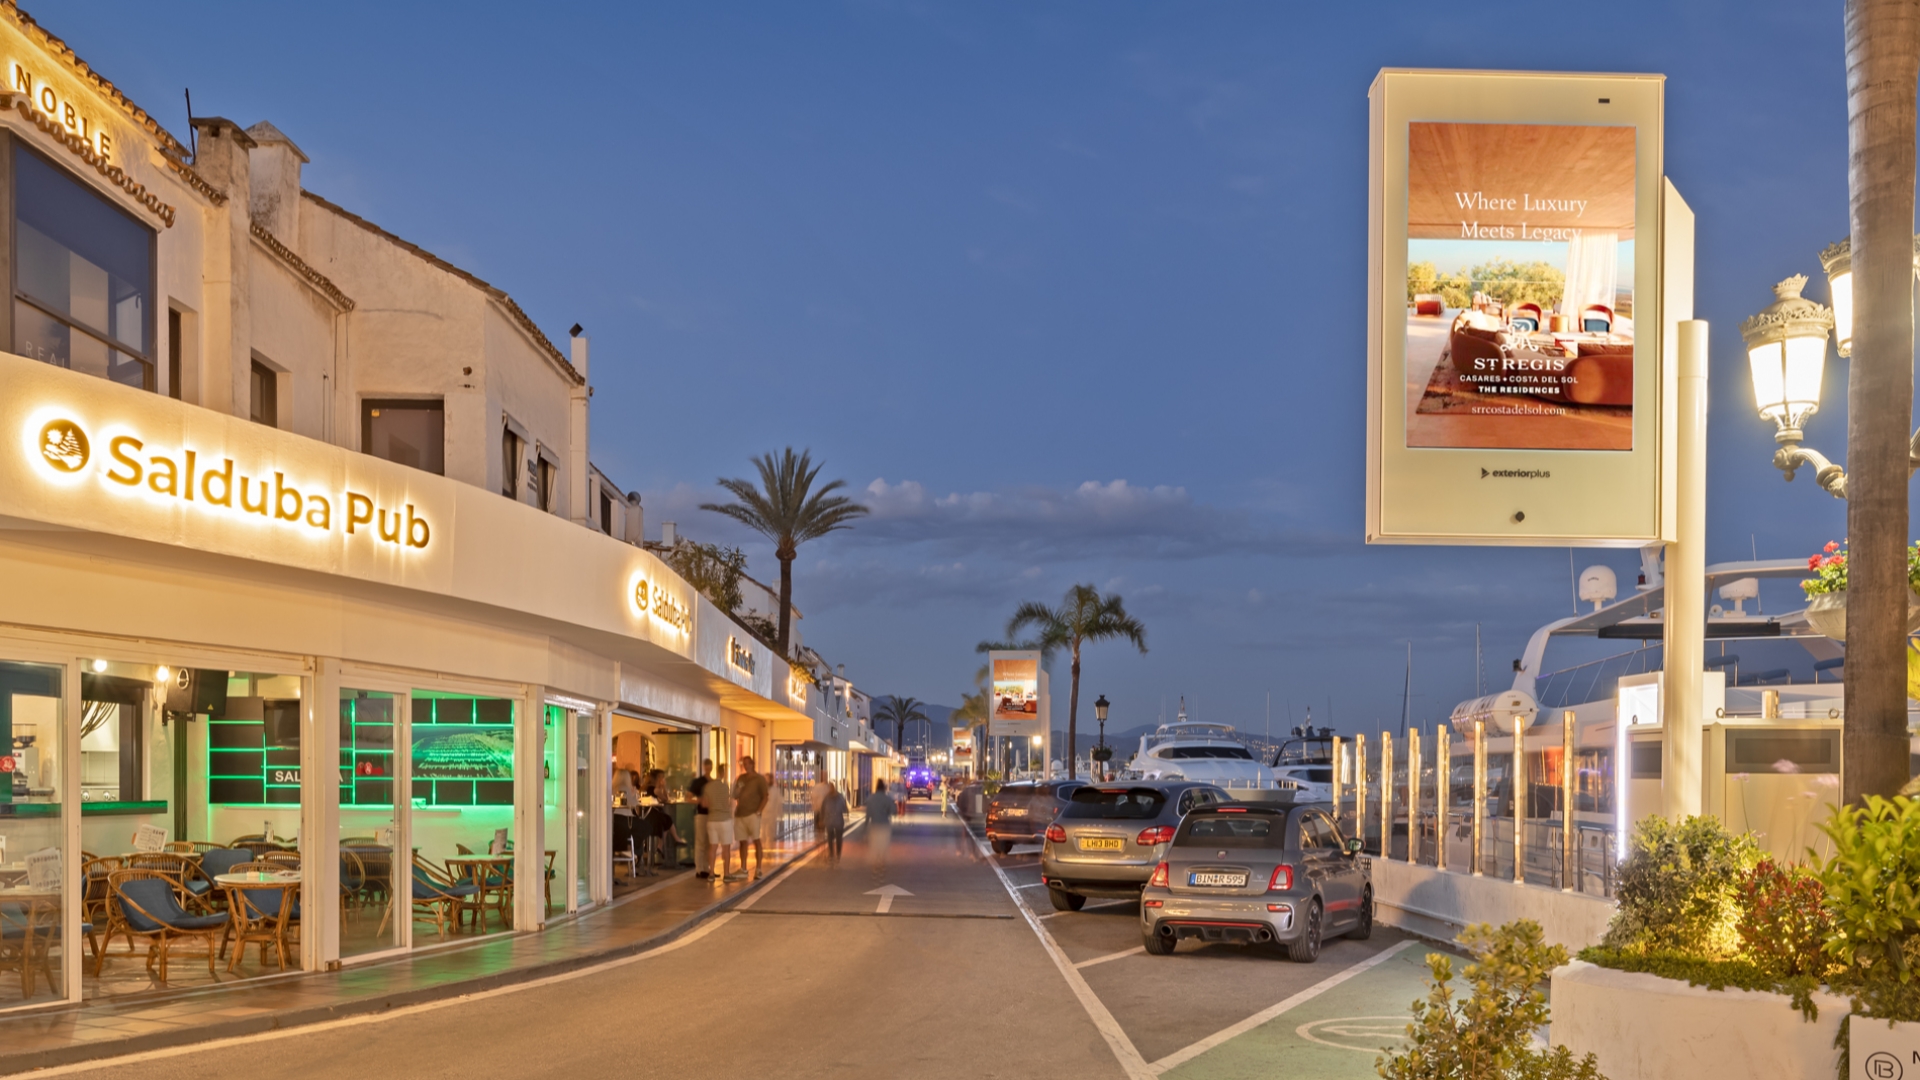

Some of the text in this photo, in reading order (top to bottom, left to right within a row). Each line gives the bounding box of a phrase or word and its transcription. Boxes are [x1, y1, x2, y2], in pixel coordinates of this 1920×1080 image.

[15, 63, 111, 161] NOBLE
[1455, 191, 1588, 218] Where Luxury
[1461, 221, 1583, 246] Meets Legacy
[1502, 358, 1565, 371] REGIS
[1459, 375, 1579, 384] CASARES COSTA DEL SOL
[1500, 386, 1560, 394] RESIDENCES
[1471, 404, 1566, 416] srrcostadelsol.com
[1492, 468, 1551, 480] exteriorplus
[106, 435, 431, 549] Salduba Pub
[1104, 839, 1119, 848] BHD
[1226, 875, 1244, 884] 595
